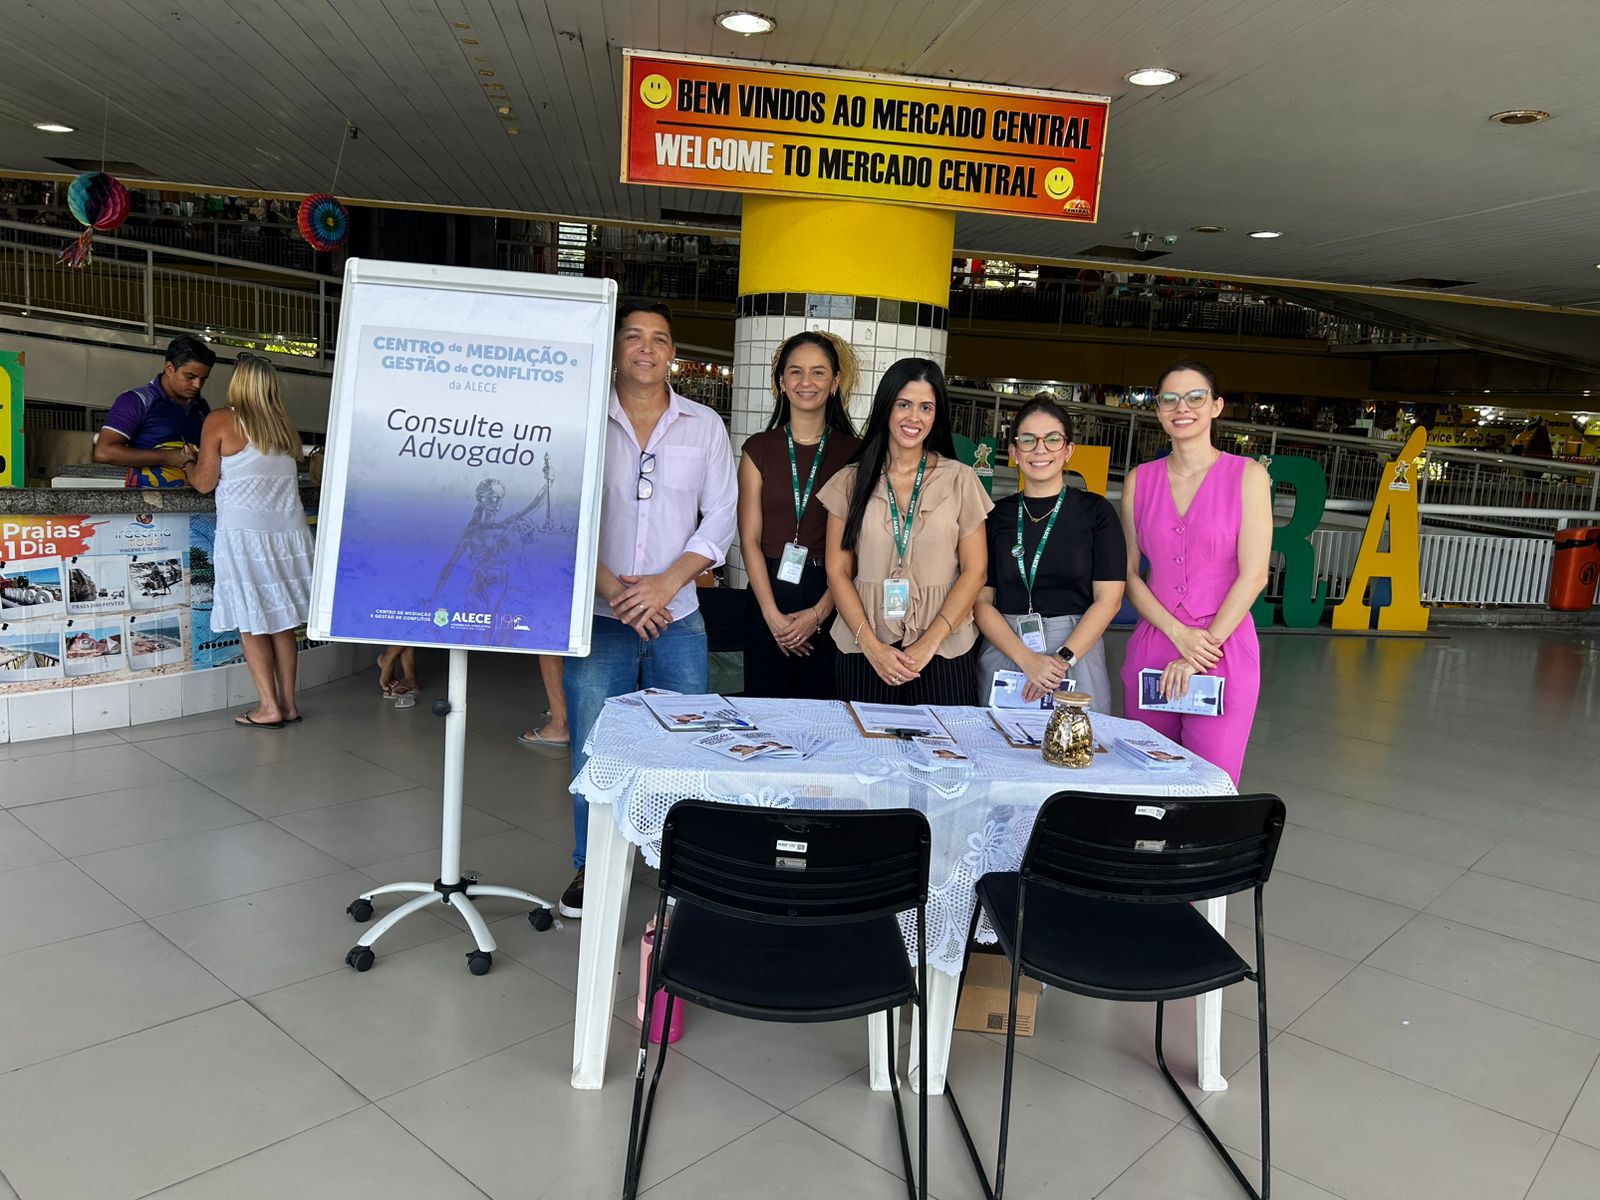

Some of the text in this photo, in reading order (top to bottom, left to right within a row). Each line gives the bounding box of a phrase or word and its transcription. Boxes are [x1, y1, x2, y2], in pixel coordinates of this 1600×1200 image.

[676, 78, 1092, 150] BEM VINDOS AO MERCADO CENTRAL
[654, 132, 1038, 198] WELCOME TO MERCADO CENTRAL
[373, 336, 579, 367] CENTRO de MEDIAÇÃO e
[381, 355, 564, 384] GESTÃO de CONFLITOS
[449, 380, 498, 393] da ALECE
[387, 408, 553, 443] Consulte um
[398, 434, 535, 467] Advogado
[3, 520, 81, 540] Praias
[5, 541, 16, 559] 1
[20, 539, 57, 556] Dia
[452, 611, 492, 624] ALECE
